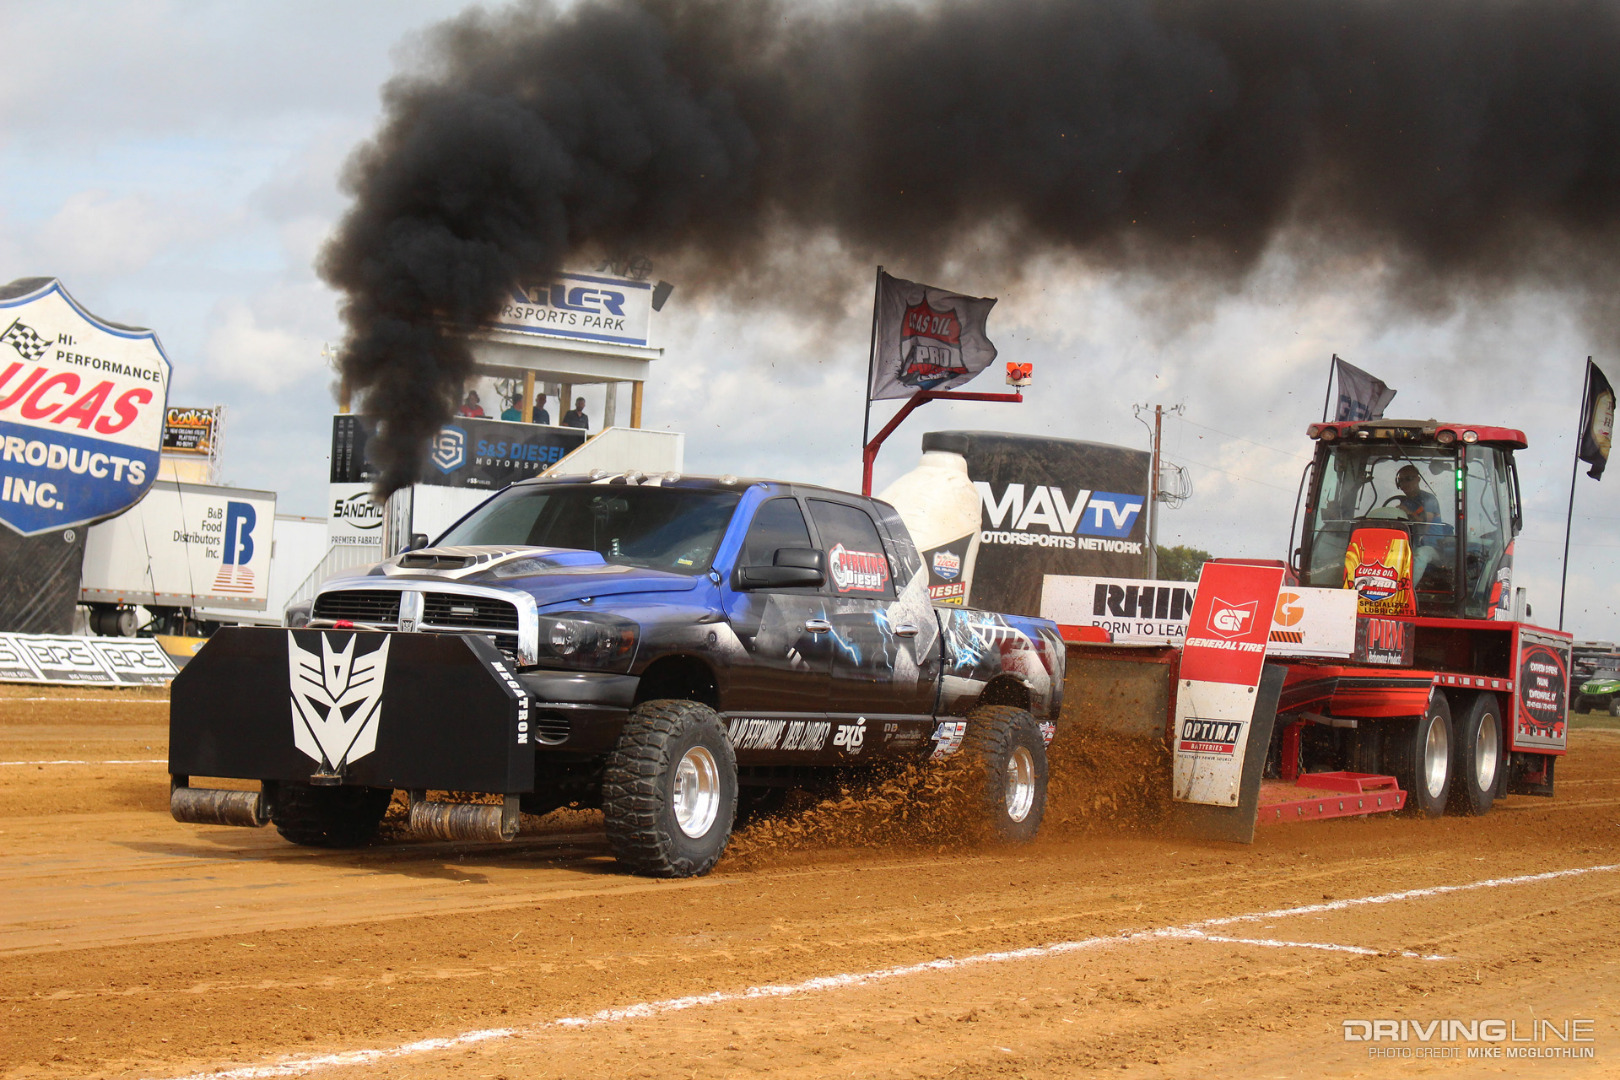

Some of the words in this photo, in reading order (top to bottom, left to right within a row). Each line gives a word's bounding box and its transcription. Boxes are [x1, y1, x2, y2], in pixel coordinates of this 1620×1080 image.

[500, 304, 577, 325] RSPORTS
[583, 314, 625, 331] PARK
[931, 317, 951, 336] OIL
[58, 333, 77, 346] HI-
[916, 345, 951, 367] PRO
[56, 350, 160, 382] PERFORMANCE
[0, 361, 153, 434] UCAS
[477, 440, 507, 458] S&S
[0, 434, 147, 486] RODUCTS
[476, 457, 548, 471] MOTORSPO
[2, 476, 64, 511] INC.
[207, 507, 223, 519] B&B
[202, 520, 222, 532] Food
[173, 530, 221, 545] Distributors
[331, 535, 356, 545] PREMIER
[358, 536, 382, 545] FABRICA
[981, 530, 1076, 550] OTORSPORTS
[1078, 537, 1142, 555] NETWORK
[206, 547, 219, 559] Inc.
[839, 552, 885, 576] PERKINS
[937, 559, 958, 568] LUCAS
[1358, 567, 1381, 576] LUCAS
[846, 569, 881, 587] Diesel
[1370, 580, 1392, 588] PRO
[1092, 583, 1196, 621] RHIN
[1360, 600, 1409, 608] SPECIALIZED
[1214, 608, 1251, 632] GT
[1364, 607, 1415, 616] LUBRICANTS
[1136, 623, 1153, 635] TO
[1159, 624, 1188, 637] LEA
[1186, 637, 1238, 650] GENERAL
[1237, 641, 1265, 653] TIRE
[491, 661, 528, 744] MEGATRON
[1183, 722, 1238, 742] OPTIMA
[1190, 743, 1223, 752] BATTERIES
